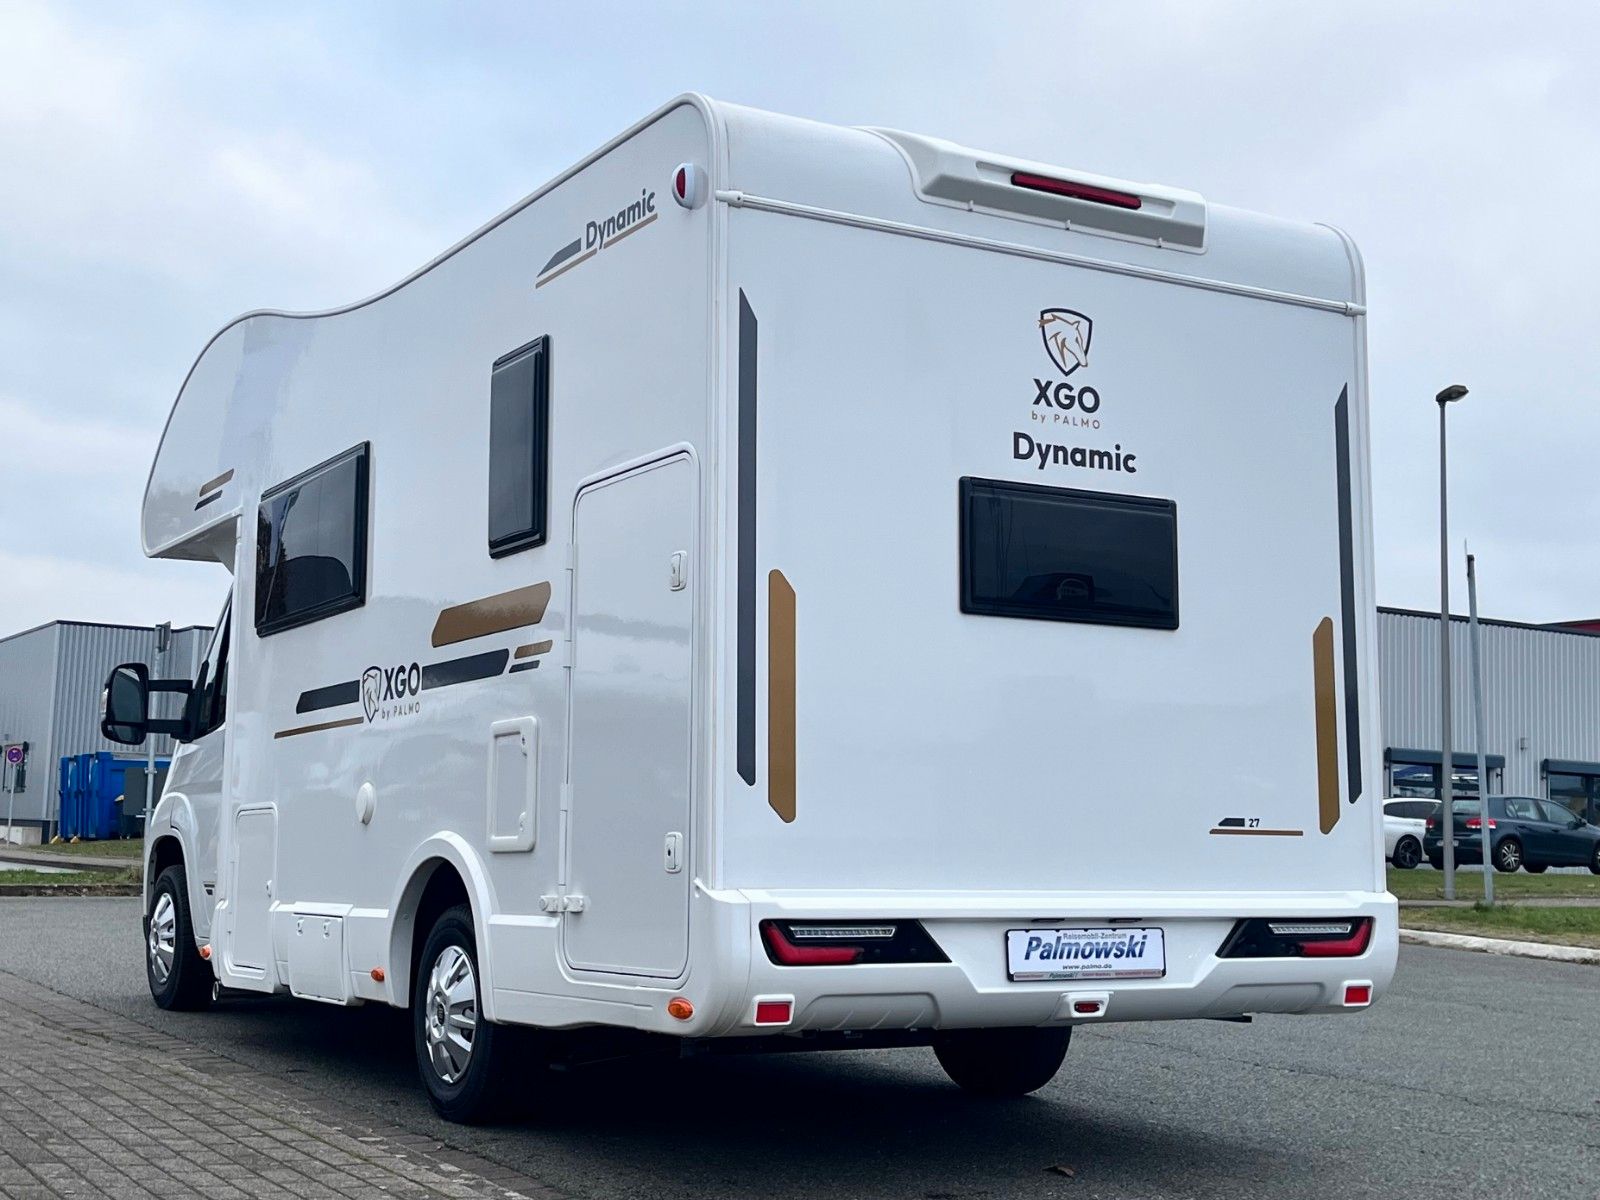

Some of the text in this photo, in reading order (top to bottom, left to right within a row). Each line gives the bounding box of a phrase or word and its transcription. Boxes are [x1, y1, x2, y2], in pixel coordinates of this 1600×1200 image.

[586, 188, 656, 250] Dynamic
[1032, 377, 1101, 414] XGO
[1031, 410, 1101, 430] by PALMO
[1013, 431, 1137, 474] Dynamic
[383, 662, 421, 702] XGO
[381, 701, 421, 721] by PALMO
[1248, 818, 1260, 828] 27
[1024, 934, 1148, 961] Palmowski
[1062, 963, 1113, 971] www.palmo.de
